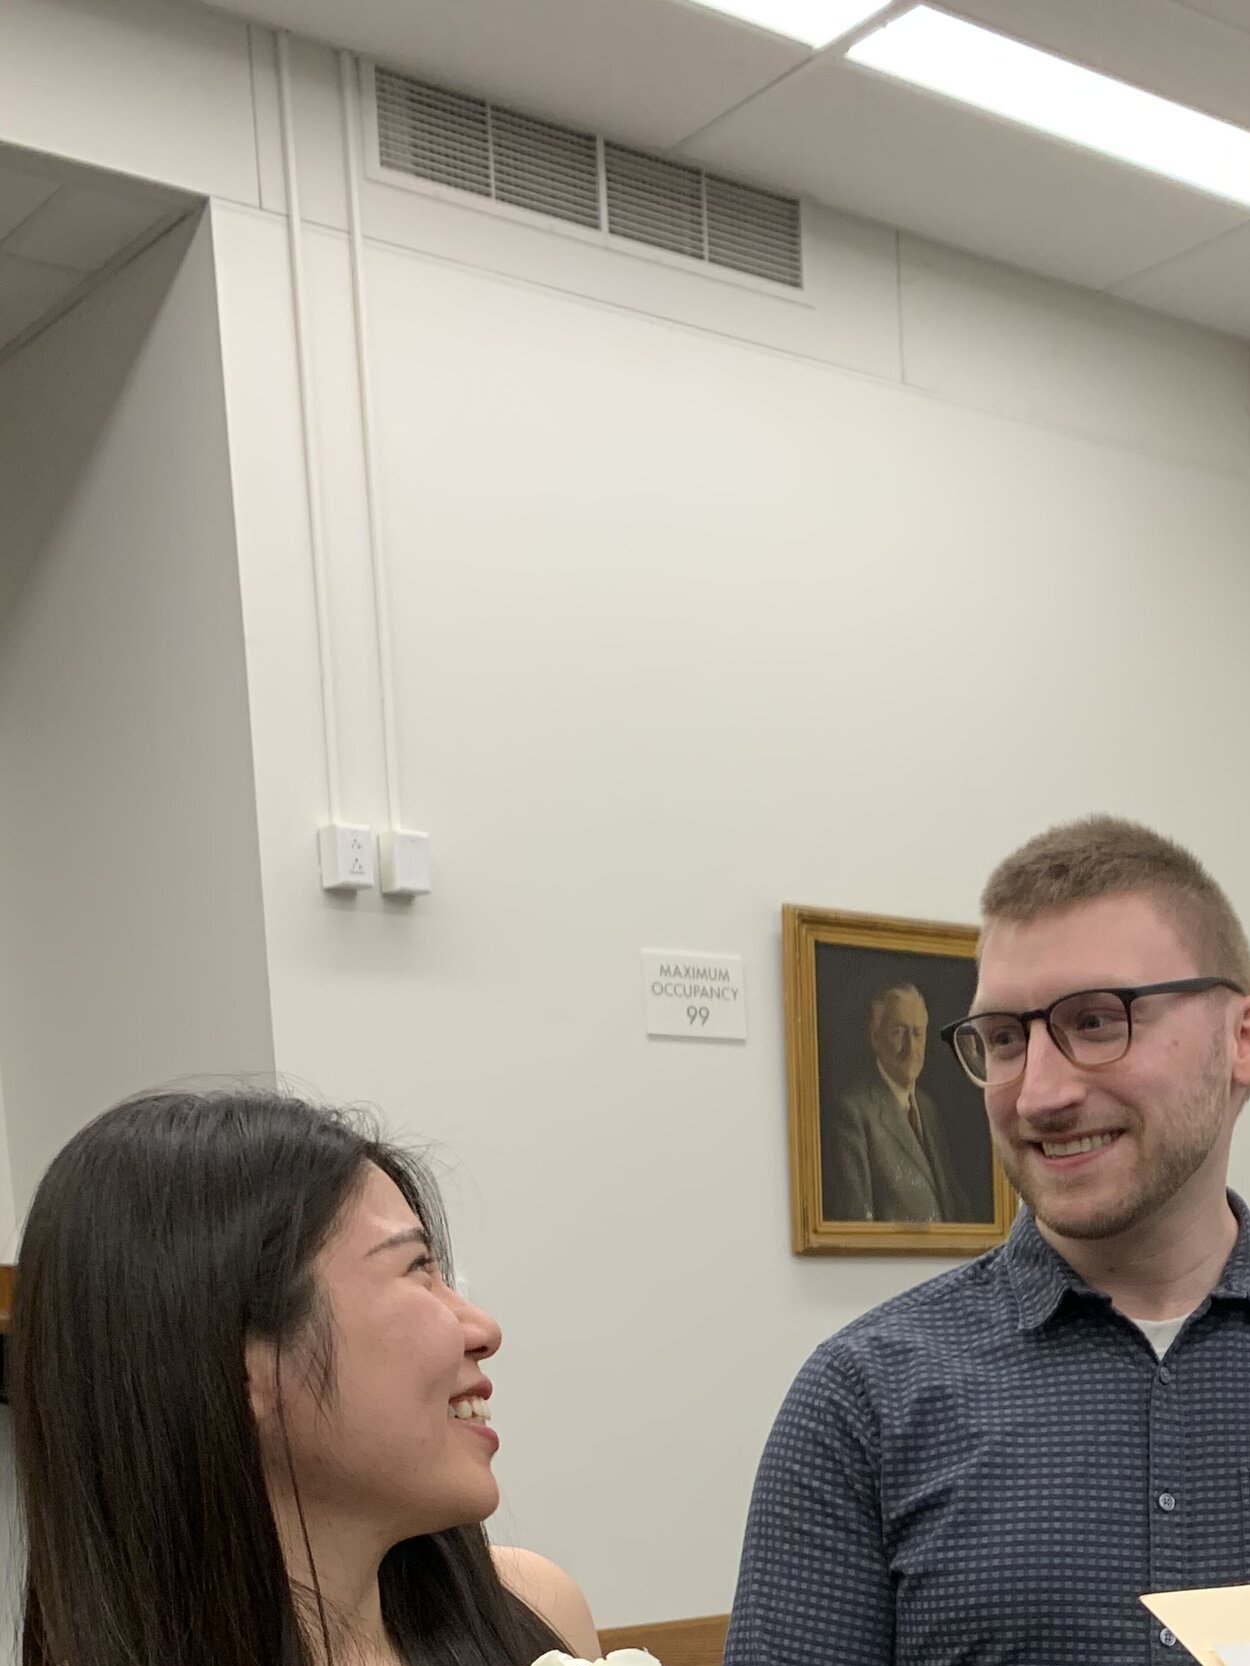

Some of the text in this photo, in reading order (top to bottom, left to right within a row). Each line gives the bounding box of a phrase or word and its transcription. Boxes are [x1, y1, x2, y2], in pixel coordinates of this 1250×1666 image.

[659, 964, 731, 982] MAXIMUM
[651, 982, 739, 1001] OCCUPANCY
[686, 1005, 710, 1026] 99
